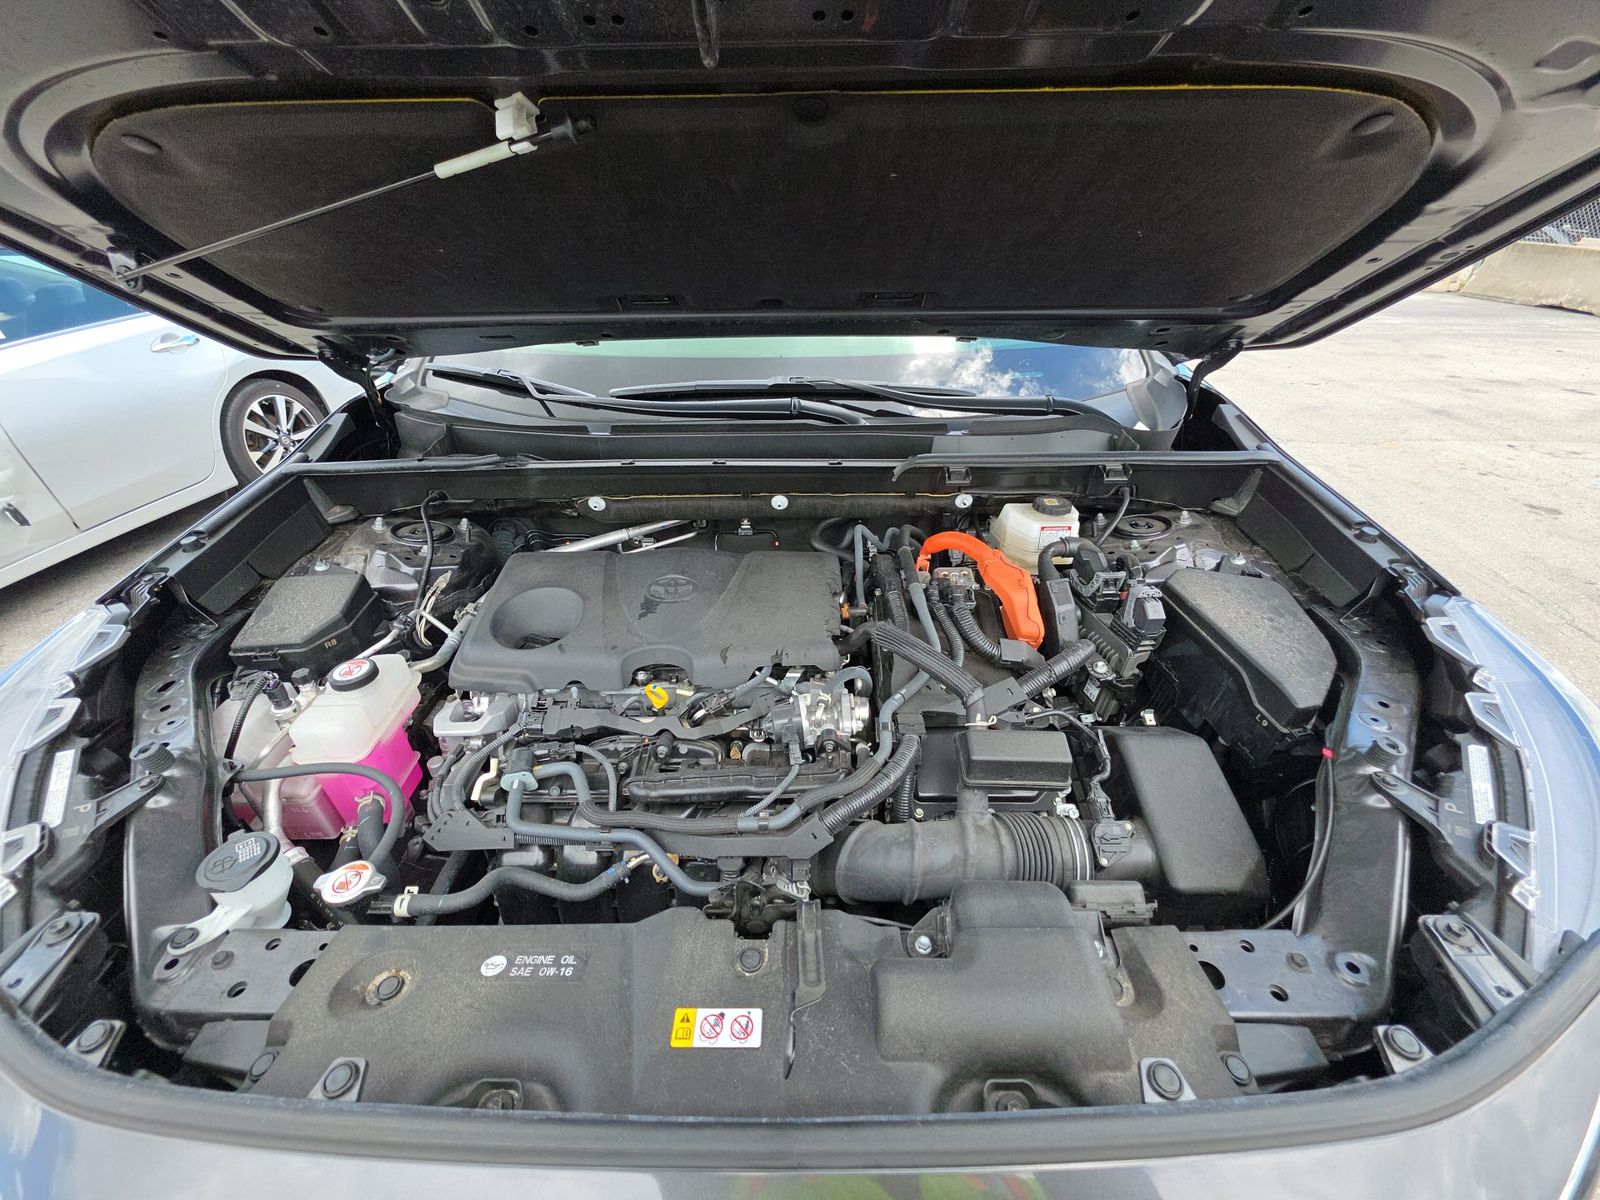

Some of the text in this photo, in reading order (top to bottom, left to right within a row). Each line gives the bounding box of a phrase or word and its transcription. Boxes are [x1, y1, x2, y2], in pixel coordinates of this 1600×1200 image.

[514, 955, 577, 965] ENGINE OIL
[509, 966, 574, 977] SAE 0W-16
